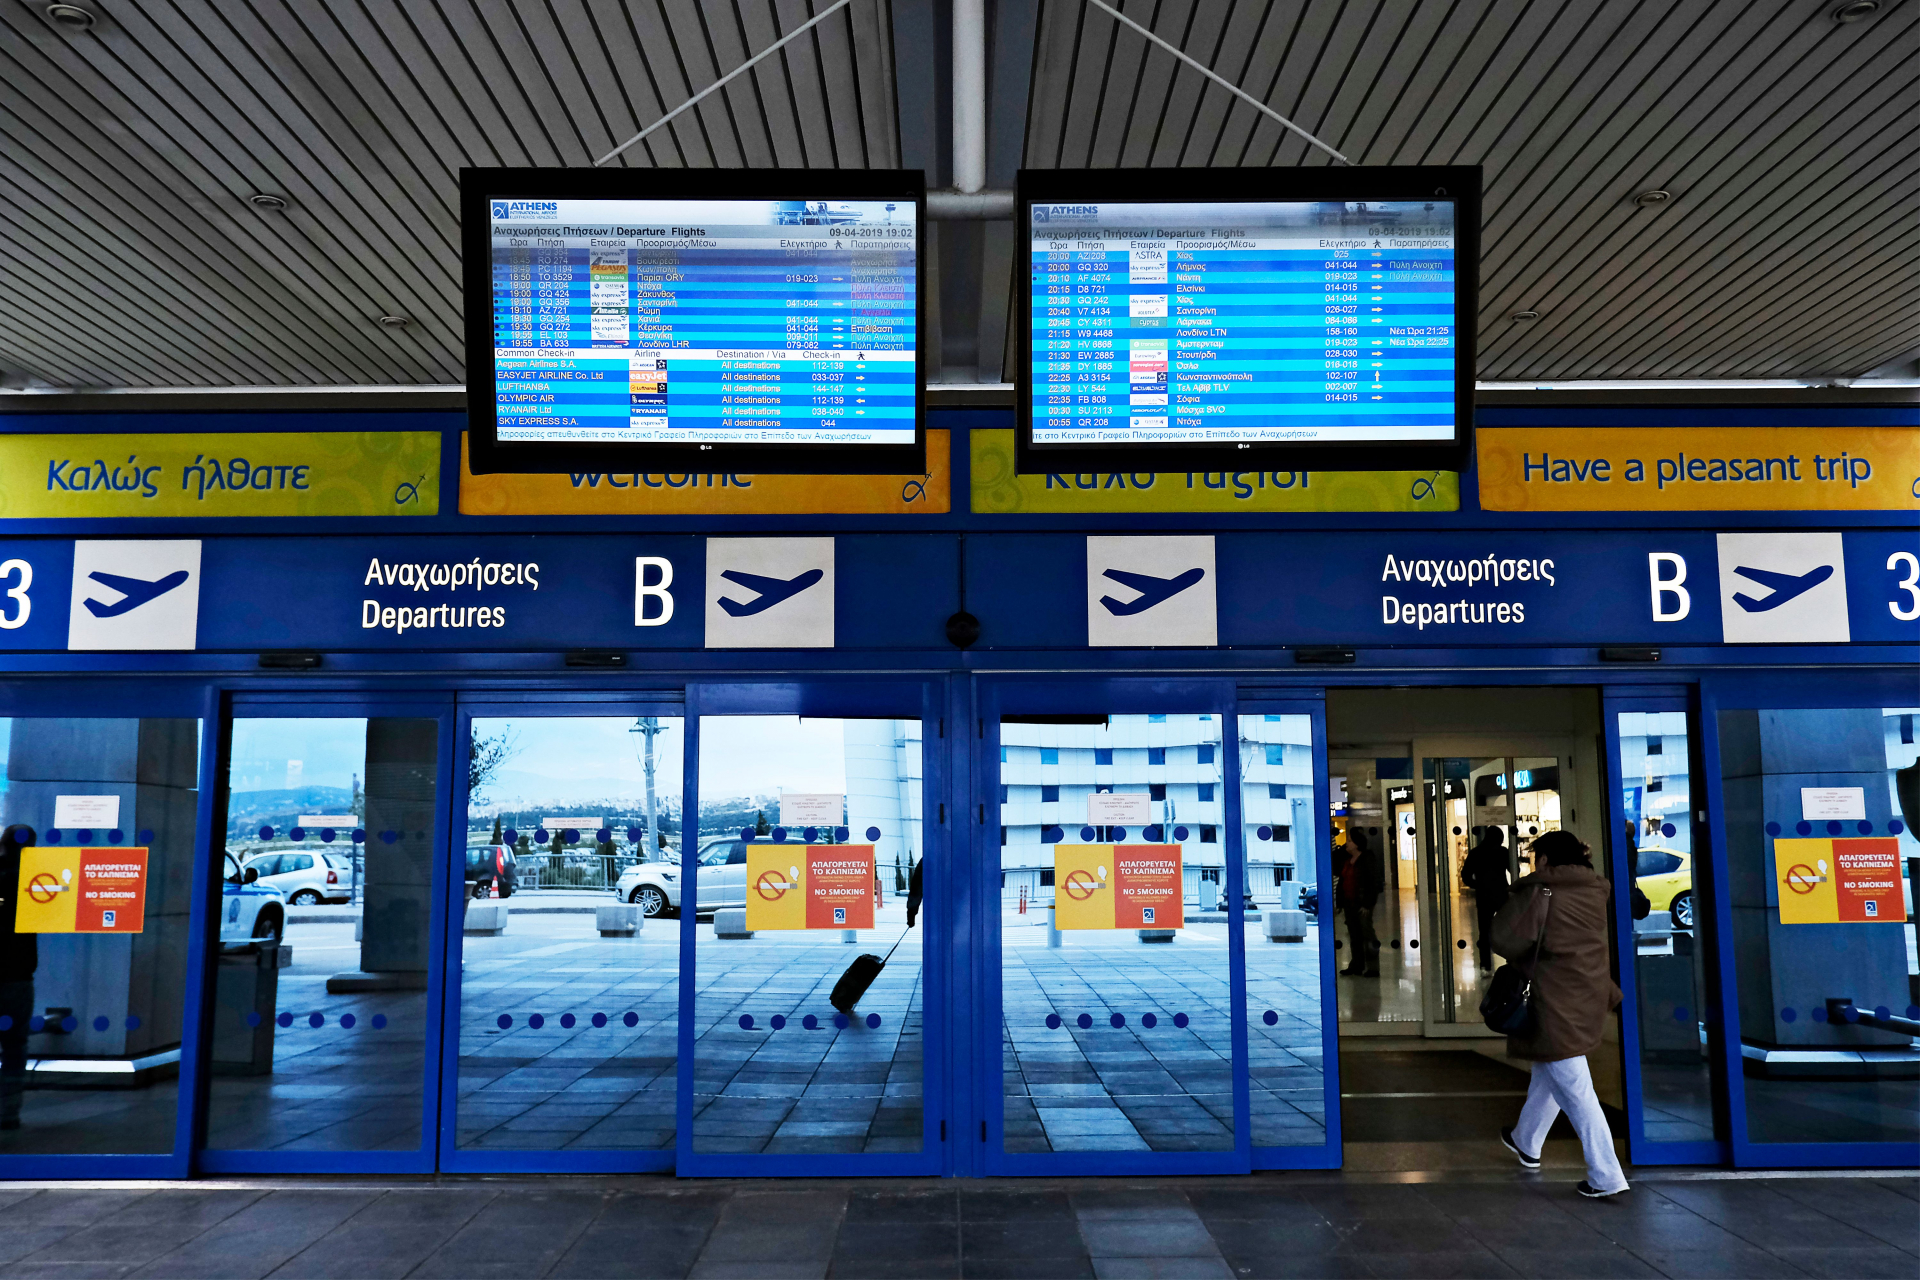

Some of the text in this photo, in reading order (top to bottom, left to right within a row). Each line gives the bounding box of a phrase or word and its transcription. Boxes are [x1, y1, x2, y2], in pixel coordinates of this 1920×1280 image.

[510, 202, 557, 210] ATHENS
[1051, 206, 1098, 214] ATHENS
[494, 227, 706, 237] Αναχωρήσεις Πτήσεων Departure Flights
[886, 229, 912, 237] 19:02
[1034, 228, 1246, 240] Αναχωρήσεις Πτήσεων Departure Flights
[537, 239, 564, 248] Πτήση
[636, 239, 716, 248] Προορισμός/Μέσω
[781, 240, 910, 250] Ελεγκτήριο Παρατηρήσεις
[1077, 241, 1104, 250] Πτήση
[1130, 241, 1165, 250] Εταιρεία
[1176, 241, 1256, 250] Προορισμός/Μέσω
[1319, 239, 1449, 248] Ελεγκτήριο Παρατηρήσεις
[1176, 263, 1206, 272] Λήμνος
[638, 307, 660, 315] Ρώμη
[1177, 307, 1216, 316] Σαντορίνη
[497, 361, 527, 369] Aegean
[630, 372, 667, 381] easyJet
[1062, 431, 1096, 440] Κεντρικό
[1098, 431, 1129, 440] Γραφείο
[1132, 431, 1186, 439] Πληροφοριών
[1206, 431, 1240, 439] Επίπεδο
[1260, 430, 1317, 438] Αναχωρήσεων
[1523, 452, 1872, 489] Have a pleasant trip
[47, 454, 310, 500] Καλώς ήλθατε
[365, 558, 540, 591] Αναχωρήσεις
[1382, 554, 1556, 587] Αναχωρήσεις
[634, 556, 674, 627] B
[1649, 552, 1690, 622] B
[1886, 552, 1920, 622] 3
[0, 558, 32, 629] 3
[361, 600, 506, 634] Departures
[1382, 596, 1525, 631] Departures
